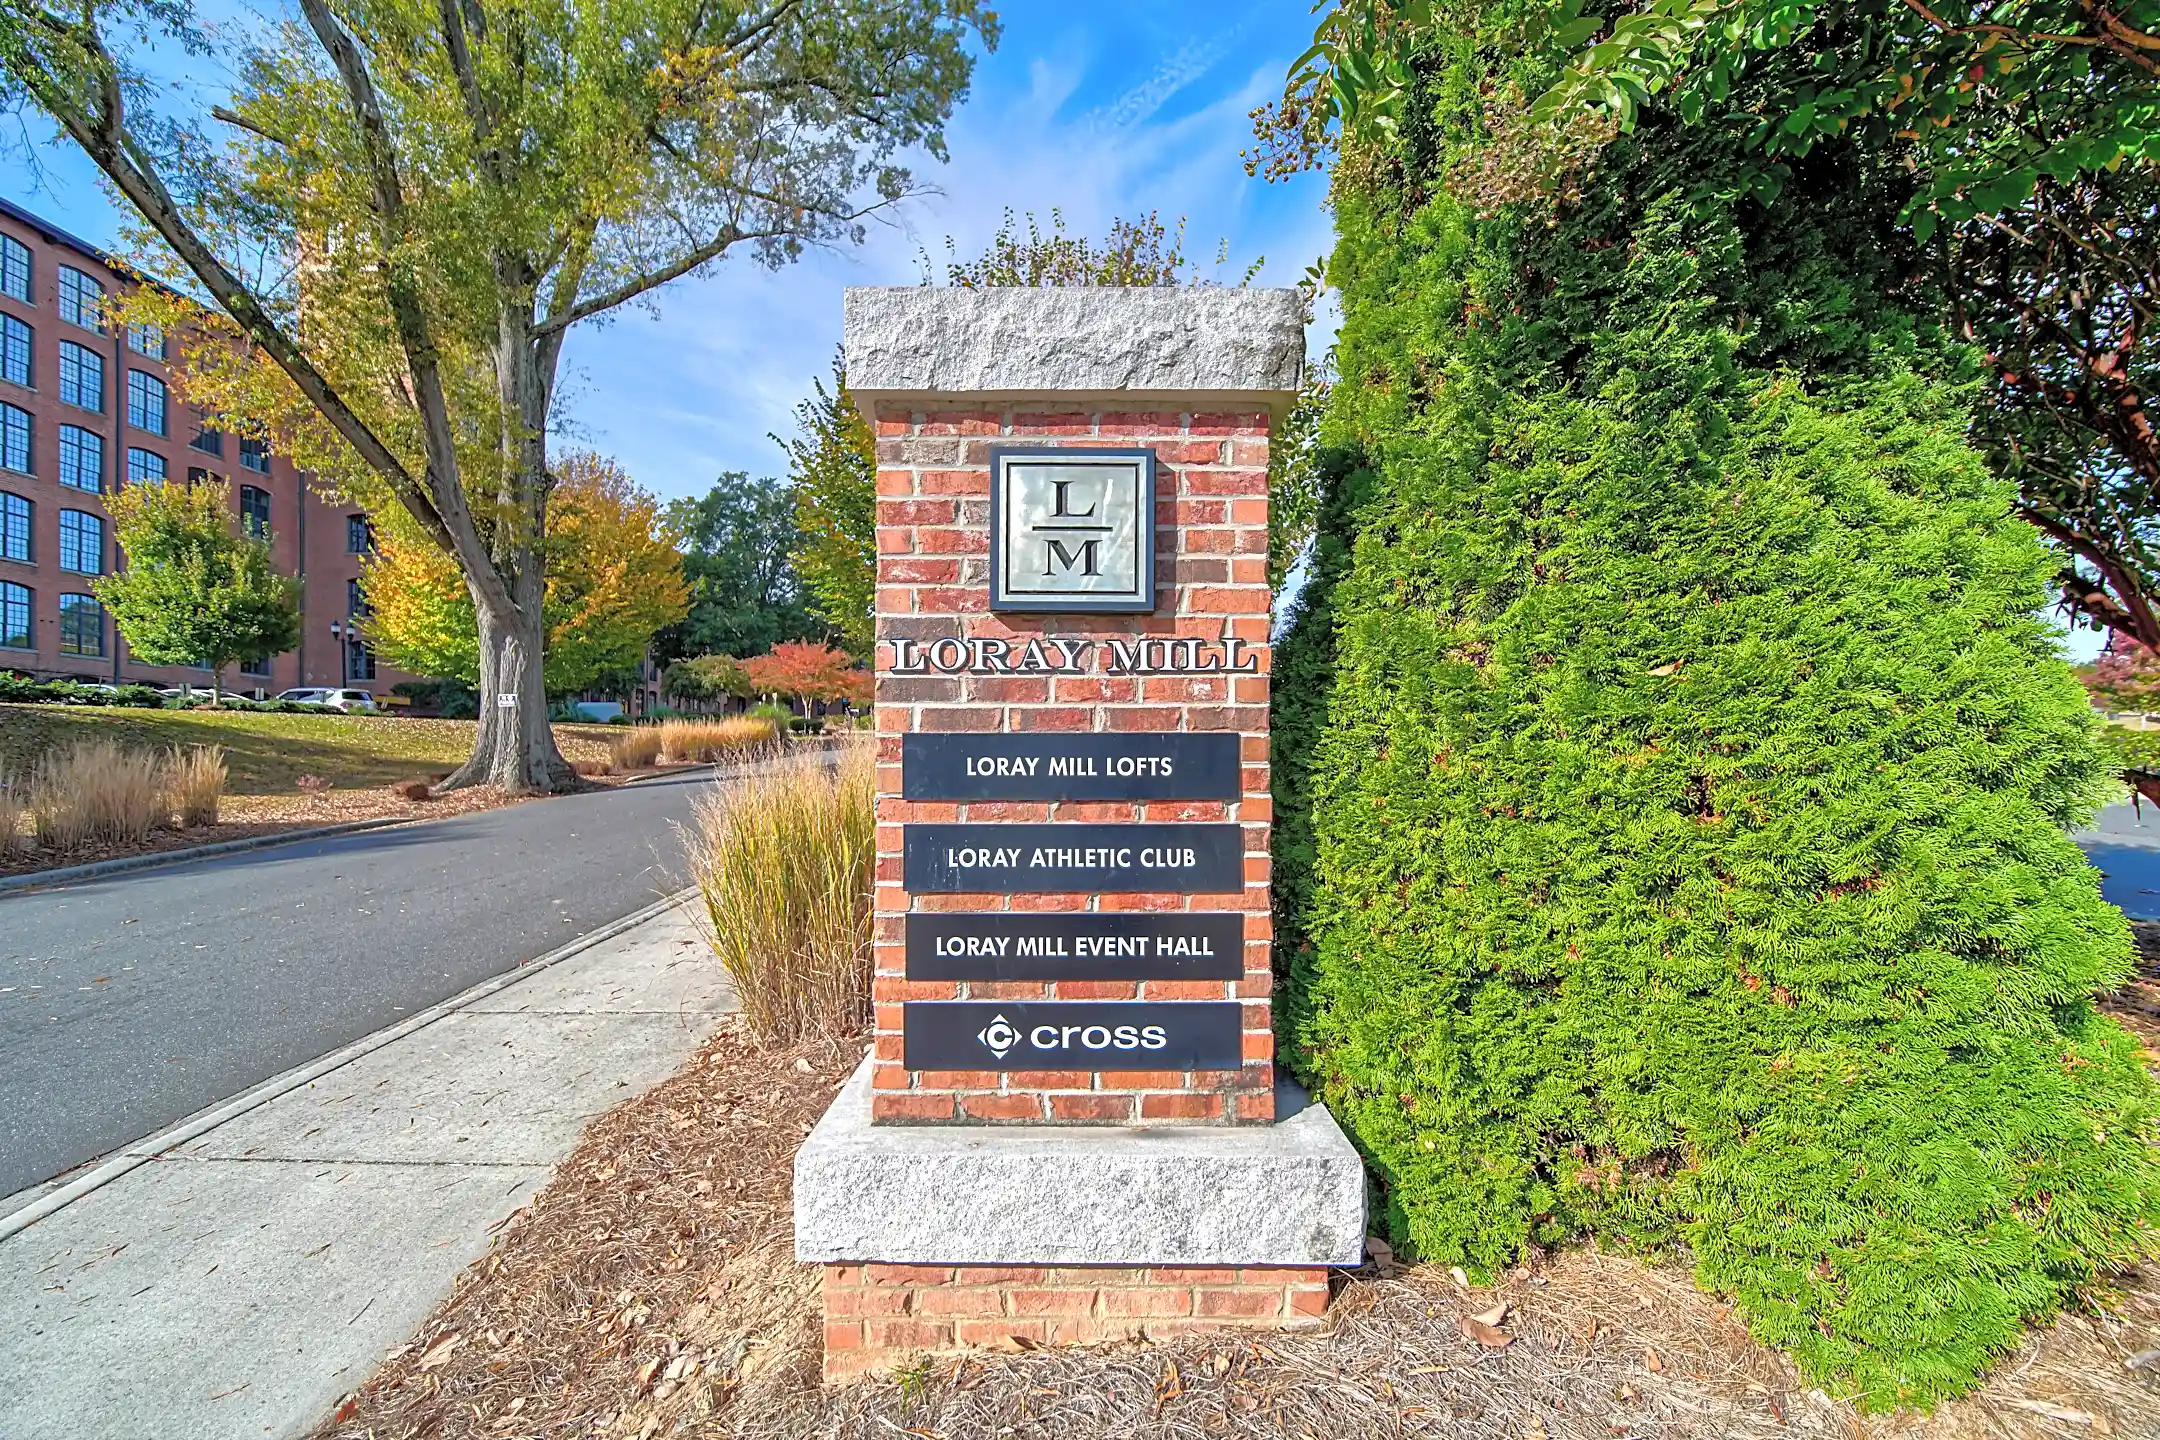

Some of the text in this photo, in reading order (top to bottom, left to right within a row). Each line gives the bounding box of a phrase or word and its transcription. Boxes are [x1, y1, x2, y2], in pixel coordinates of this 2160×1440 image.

[1049, 481, 1096, 517] L
[1041, 539, 1103, 576] M
[890, 637, 1259, 675] LORAY MILL
[966, 756, 1172, 776] LORAY MILL LOFTS
[948, 848, 1196, 867] LORAY ATHLETIC CLUB
[936, 936, 1214, 956] LORAY MILL EVENT HALL
[1030, 1025, 1167, 1049] cross
